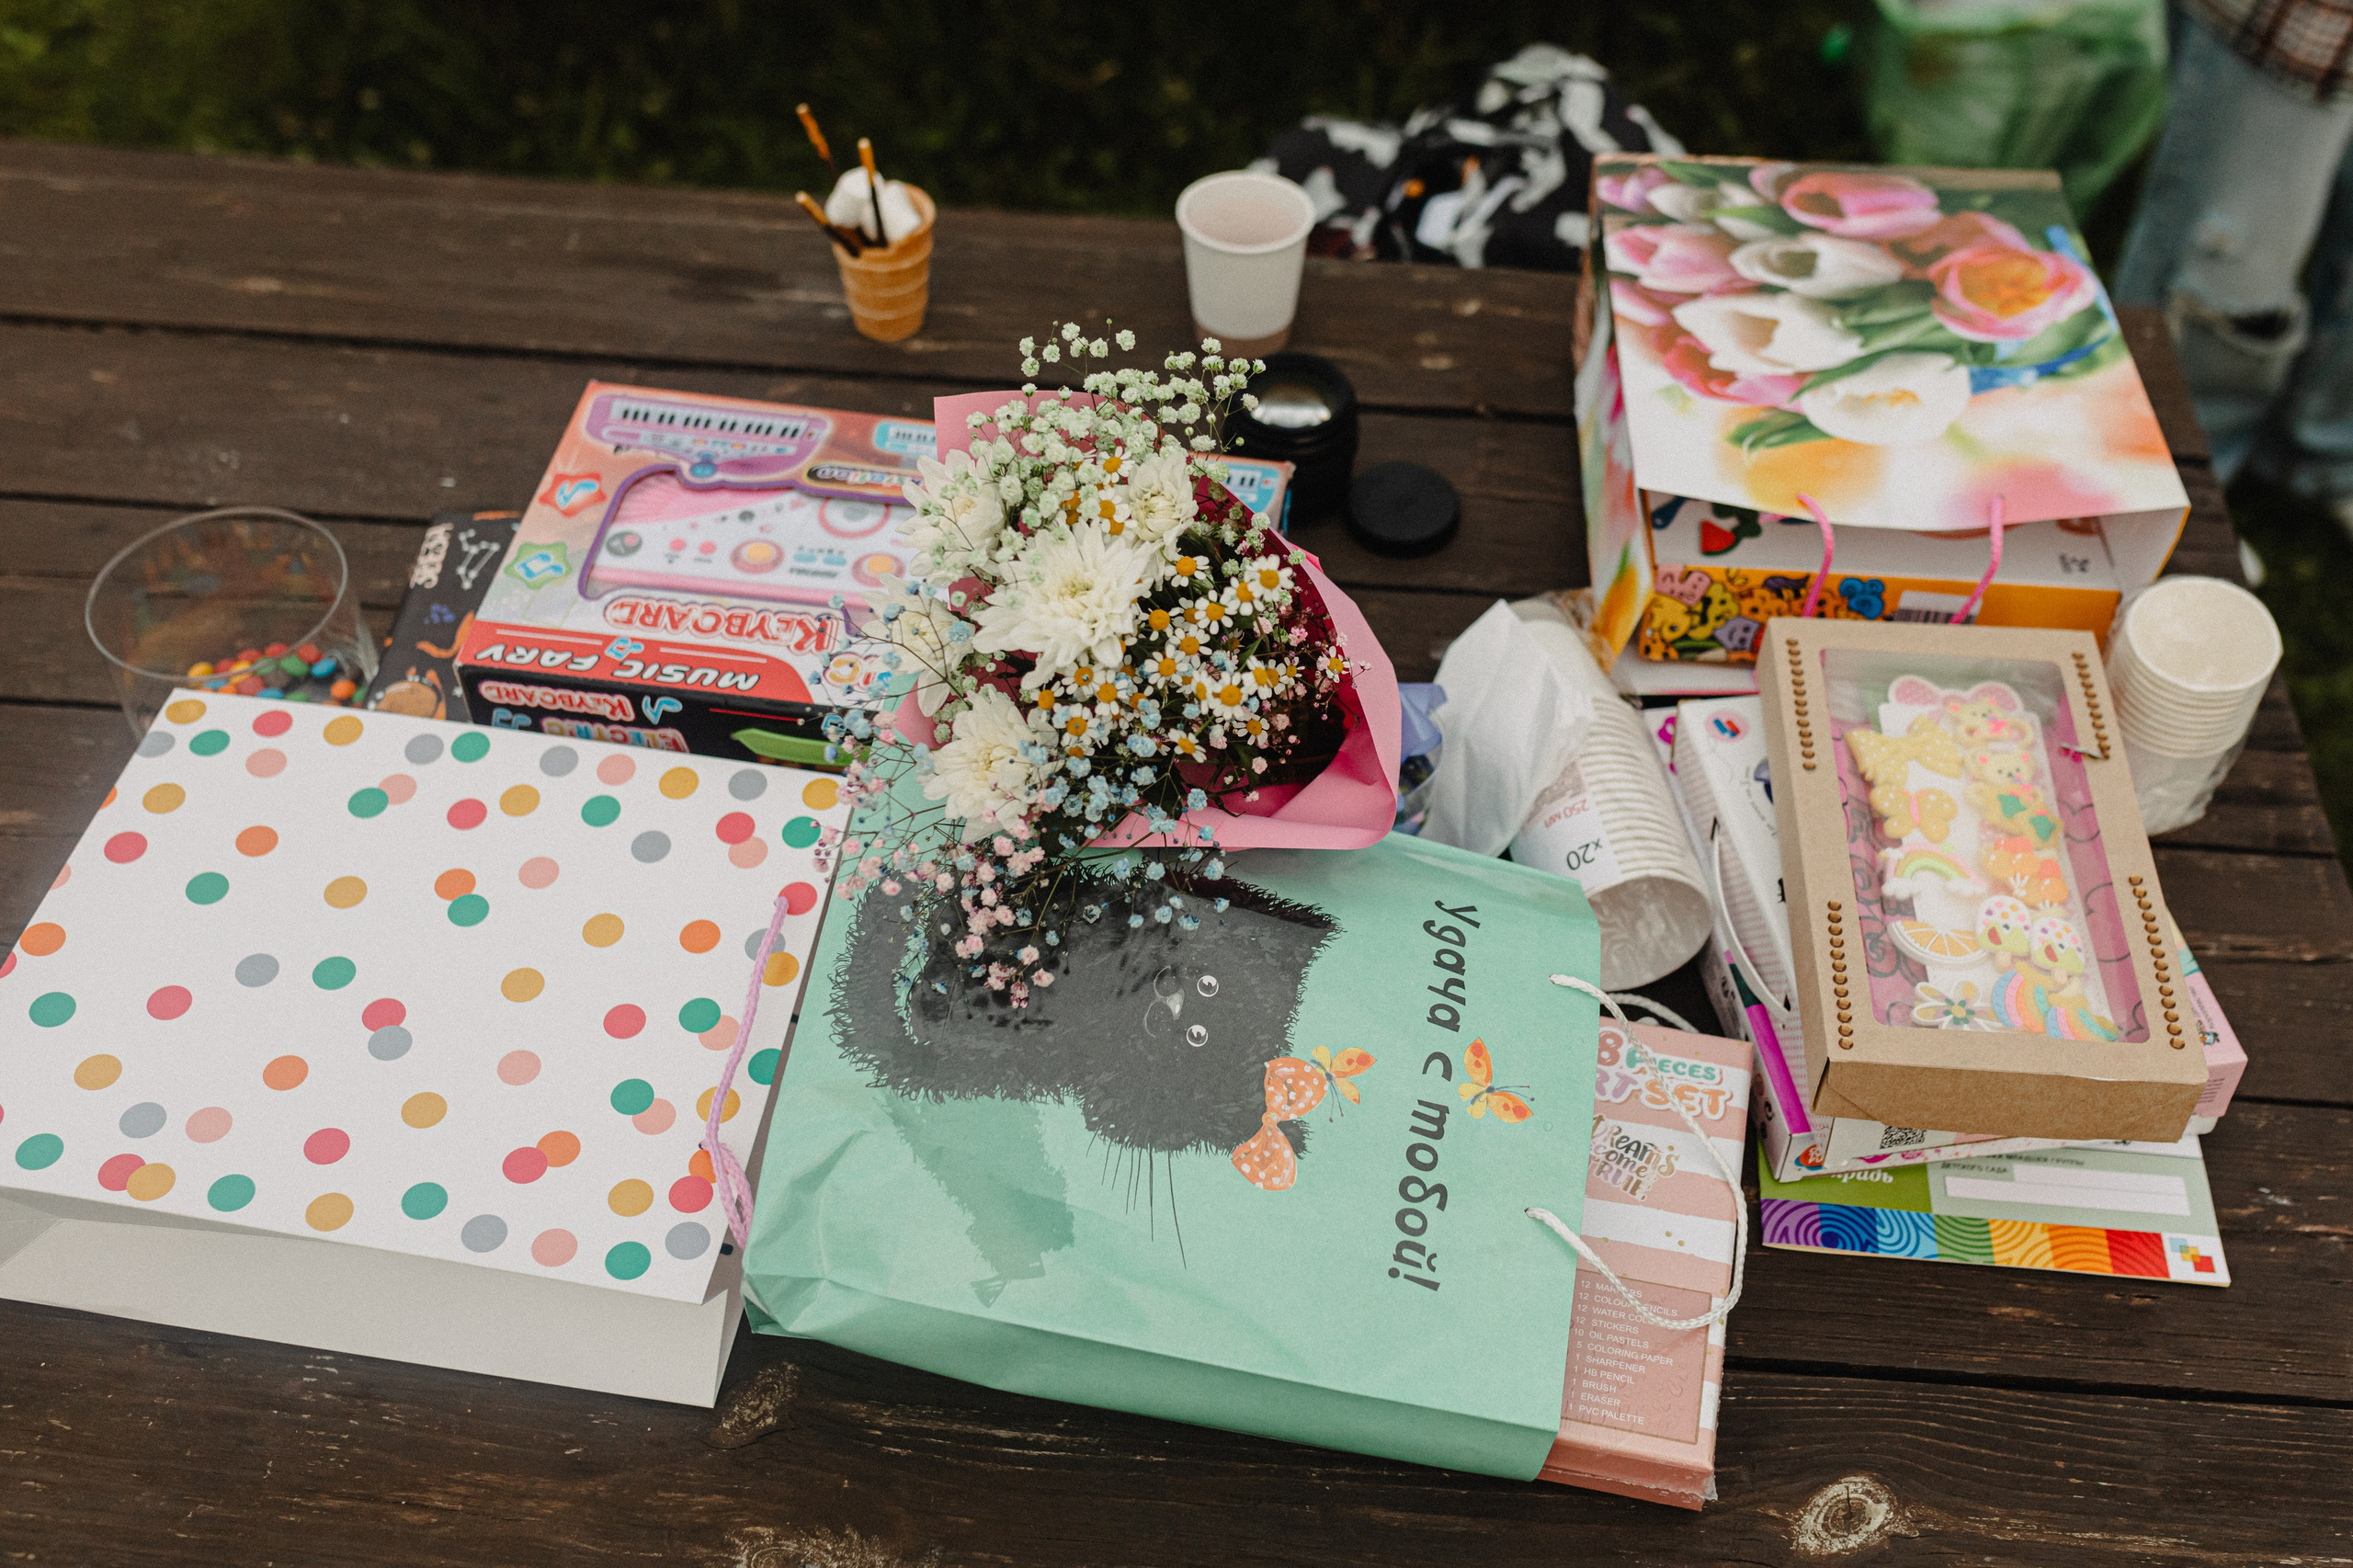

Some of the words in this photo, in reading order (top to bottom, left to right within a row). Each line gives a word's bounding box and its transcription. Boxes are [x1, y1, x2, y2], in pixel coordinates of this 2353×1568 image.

[607, 600, 833, 653] KEYBOARD
[475, 643, 600, 672] FARY
[613, 659, 762, 691] MUSIC
[480, 681, 635, 721] KEYBOARD
[1566, 838, 1603, 870] x20
[1422, 900, 1481, 1033] Удача
[1645, 1080, 1726, 1115] SET
[1388, 1099, 1450, 1292] тобой!
[1596, 1282, 1643, 1299] MARRS
[1592, 1306, 1626, 1320] WATER
[1591, 1318, 1640, 1335] STICKERS
[1588, 1330, 1605, 1341] OIL
[1606, 1334, 1650, 1349] PASTELS
[1586, 1355, 1646, 1374] SHARPENER
[1587, 1343, 1639, 1359] COLORING
[1641, 1353, 1674, 1367] PAPER
[1582, 1380, 1617, 1393] BRUSH
[1584, 1367, 1597, 1377] HB
[1599, 1370, 1635, 1384] PENCIL
[1580, 1392, 1621, 1407] ERASER
[1578, 1404, 1599, 1416] PVC
[1601, 1409, 1645, 1426] PALETTE
